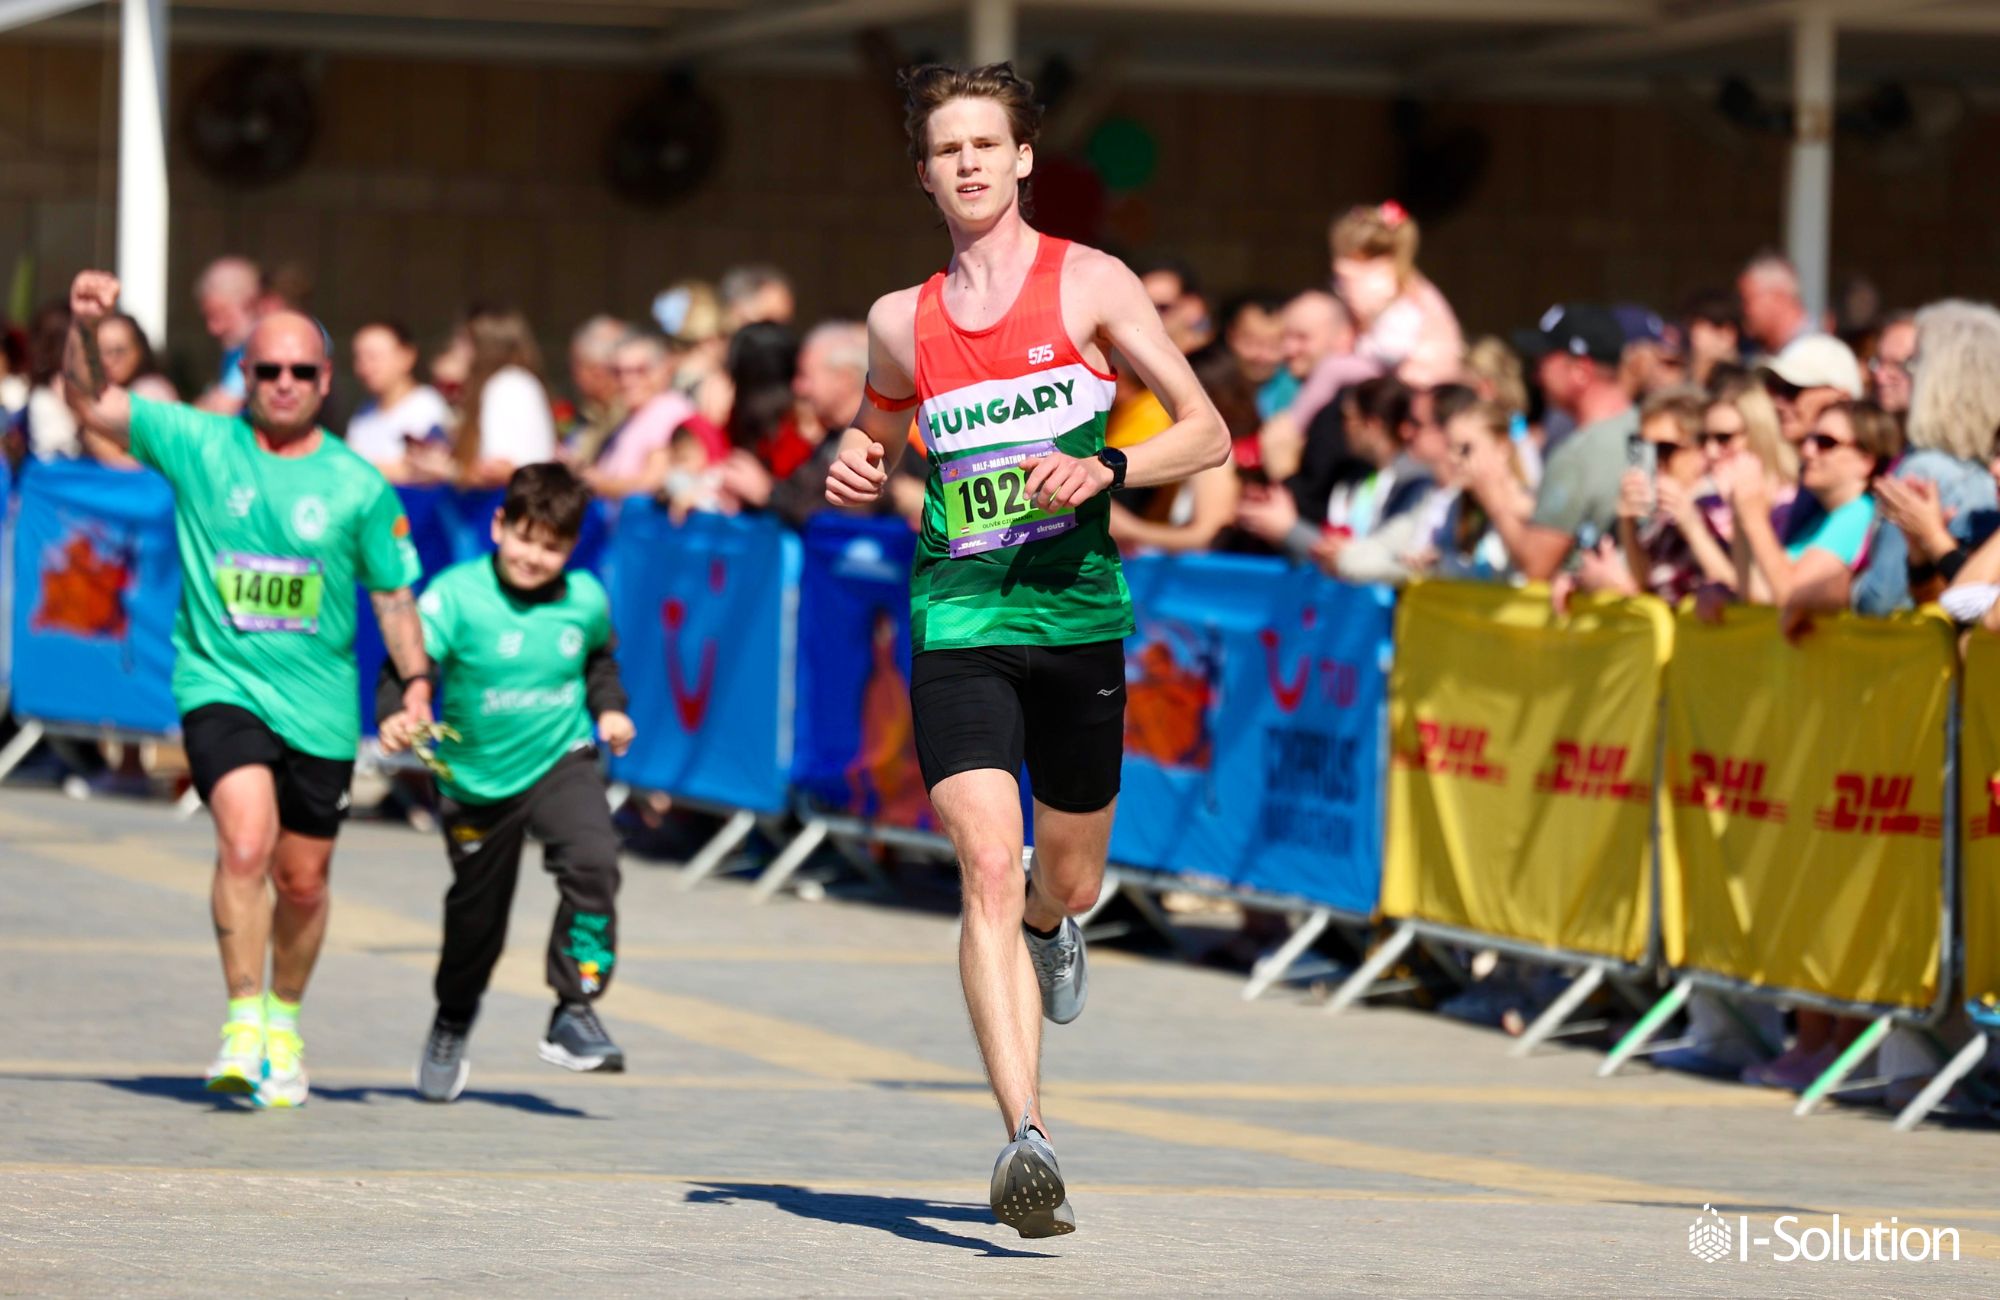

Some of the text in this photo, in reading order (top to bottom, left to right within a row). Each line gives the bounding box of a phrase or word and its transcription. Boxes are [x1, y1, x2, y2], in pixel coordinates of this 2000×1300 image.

[1027, 343, 1055, 365] 575
[929, 379, 1075, 439] HUNGARY
[958, 471, 1043, 523] 192
[1036, 521, 1065, 533] skroutz
[235, 574, 304, 609] 1408
[1405, 721, 1497, 782] DHL
[1545, 740, 1641, 801] DHL
[1682, 753, 1777, 823] DHL
[1825, 773, 1931, 837] DHL
